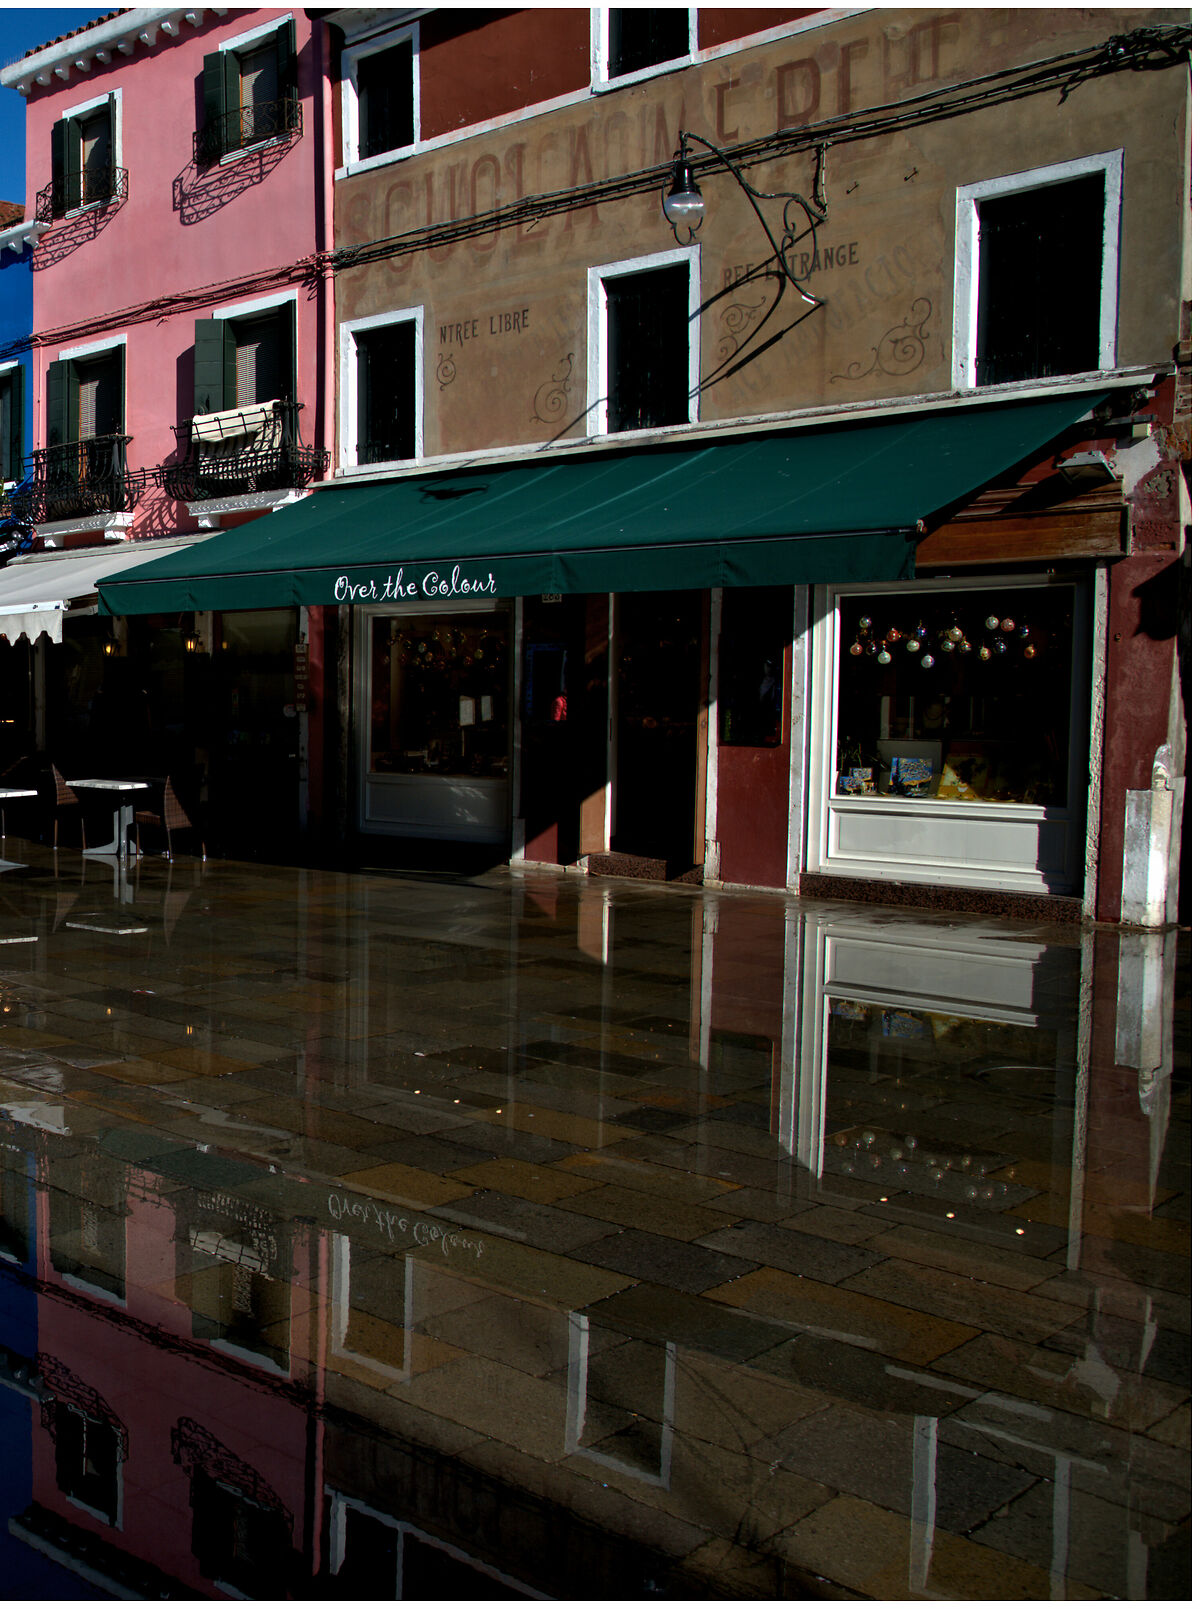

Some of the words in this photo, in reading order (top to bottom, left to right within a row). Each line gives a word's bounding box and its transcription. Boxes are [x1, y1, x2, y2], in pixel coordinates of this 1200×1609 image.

[490, 309, 529, 334] LIBRE
[334, 576, 378, 600] Over
[380, 568, 417, 601] the
[422, 565, 497, 597] Colour
